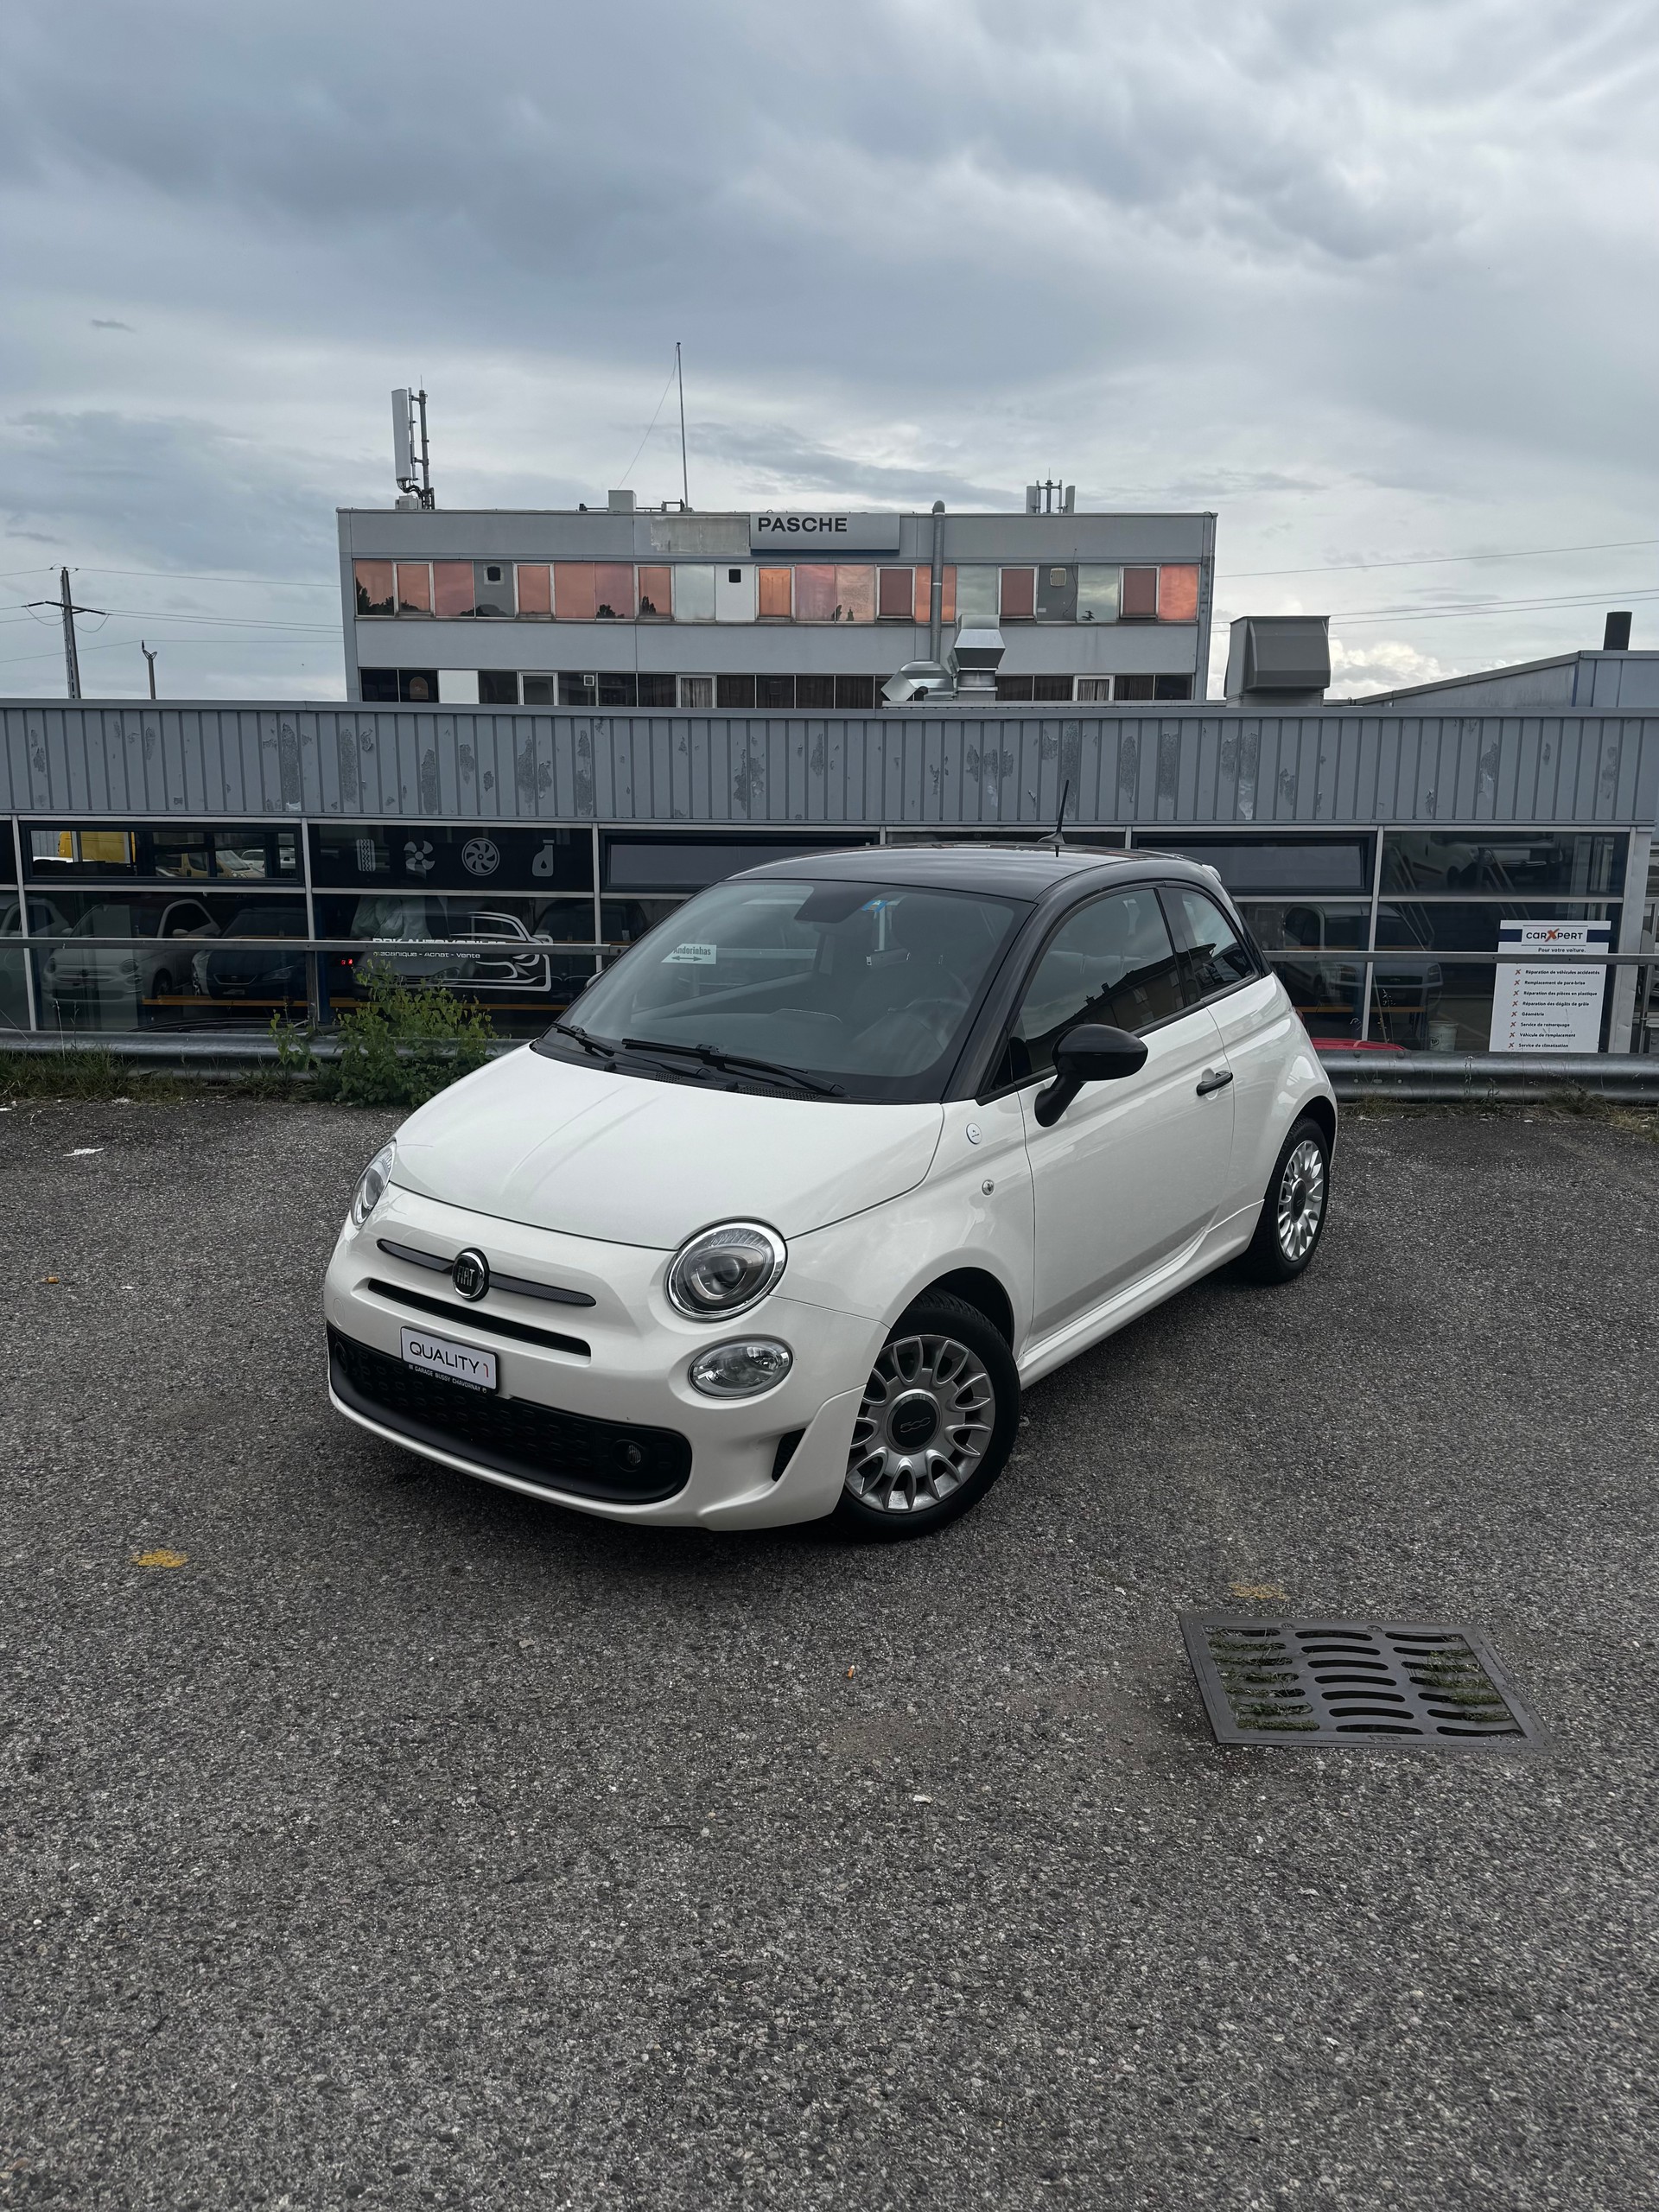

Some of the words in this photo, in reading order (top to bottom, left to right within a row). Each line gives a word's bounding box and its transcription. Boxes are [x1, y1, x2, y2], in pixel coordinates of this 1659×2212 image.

[758, 517, 848, 532] PASCHE
[456, 1265, 475, 1287] FIAT
[410, 1341, 480, 1374] QUALITY
[483, 1363, 489, 1378] 1
[414, 1366, 434, 1377] GARAGE
[435, 1372, 451, 1382] BUSSY
